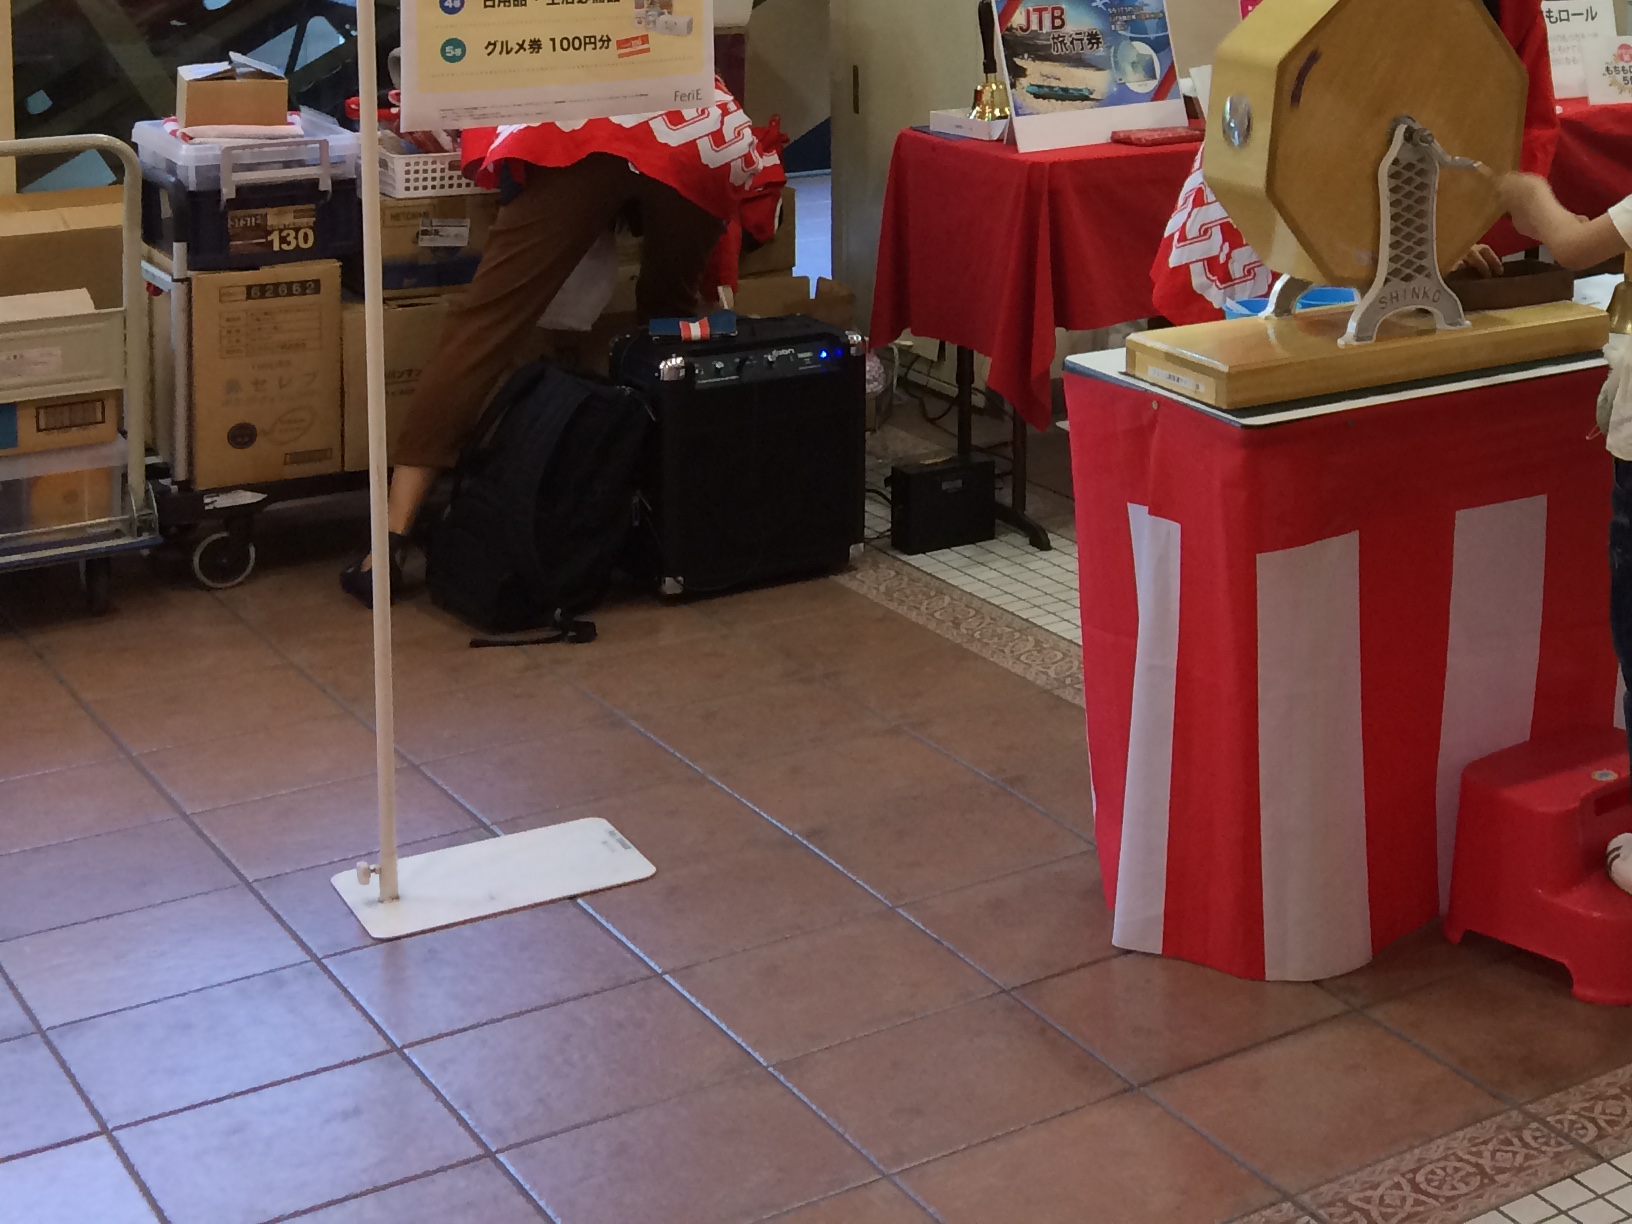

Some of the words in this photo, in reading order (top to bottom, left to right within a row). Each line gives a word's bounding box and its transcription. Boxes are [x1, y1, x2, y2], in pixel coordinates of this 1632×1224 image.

[1018, 4, 1066, 35] JTB
[1545, 6, 1598, 25] もロール
[484, 38, 543, 56] グルメ券
[549, 35, 612, 53] 100円分
[1050, 29, 1103, 55] 旅行券
[673, 88, 703, 103] FeriE
[267, 227, 315, 251] 130
